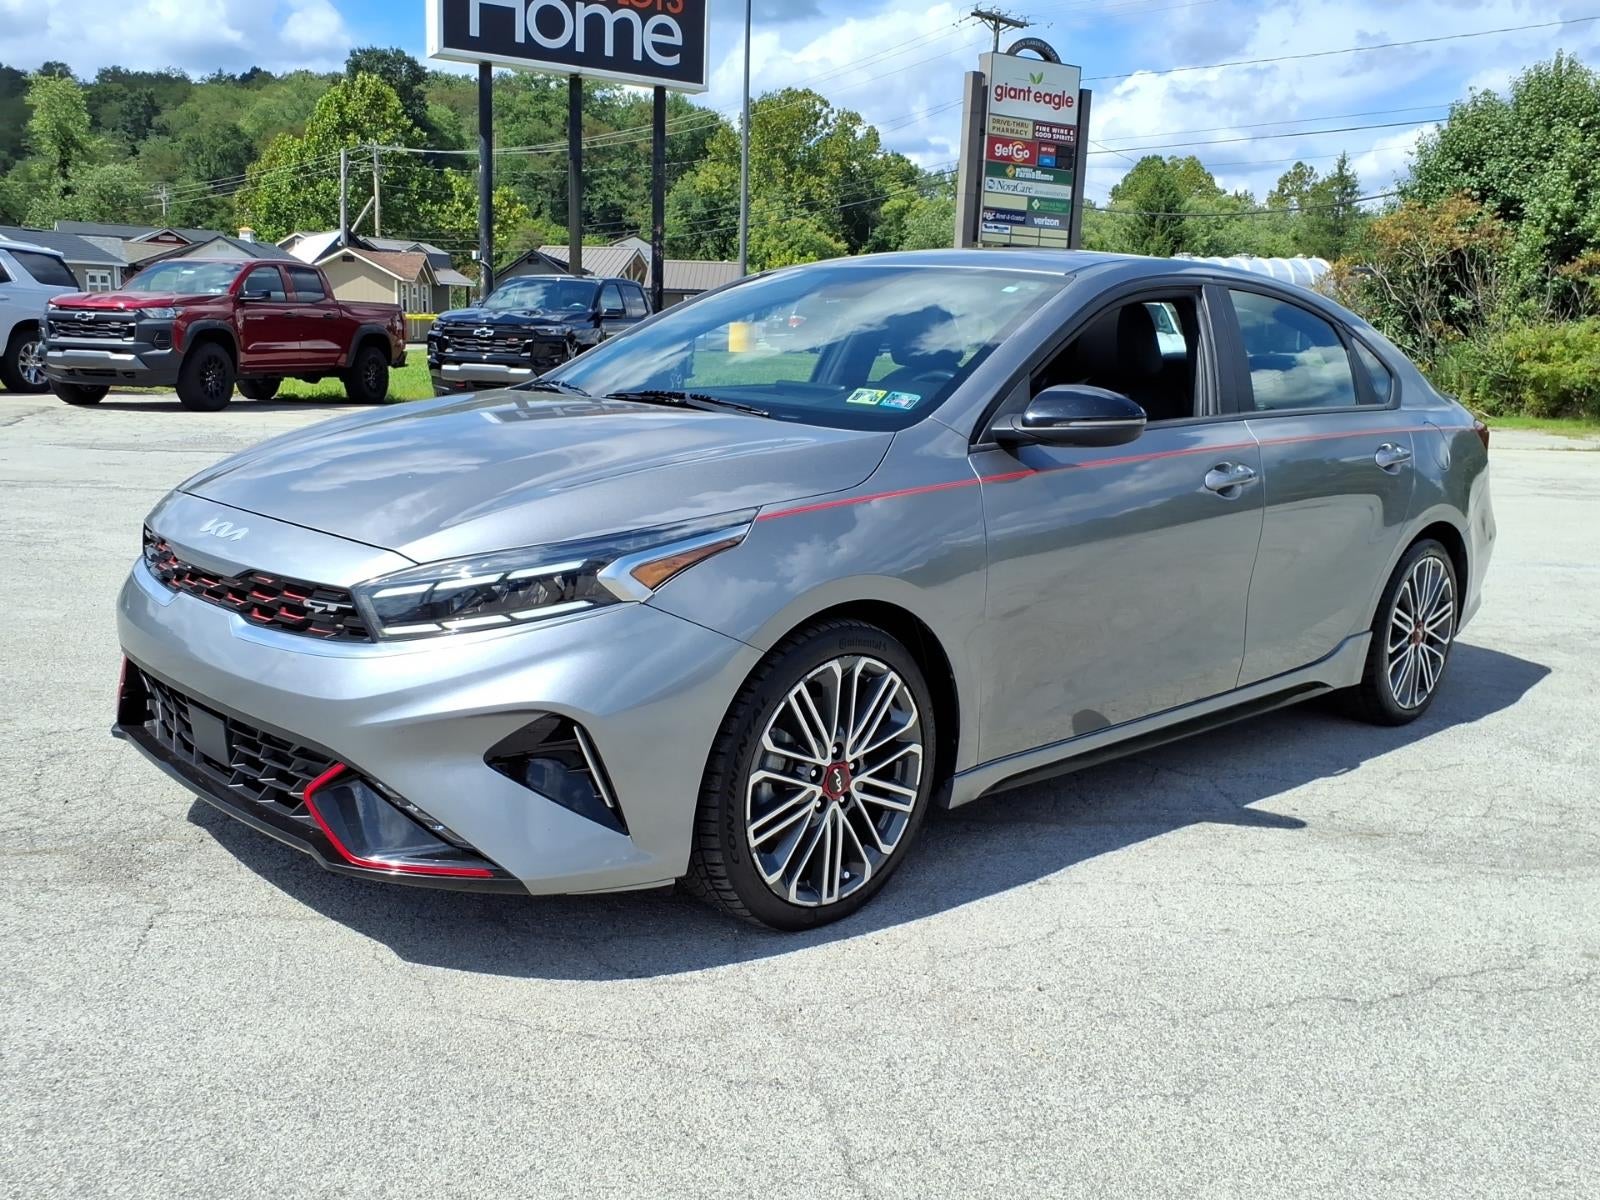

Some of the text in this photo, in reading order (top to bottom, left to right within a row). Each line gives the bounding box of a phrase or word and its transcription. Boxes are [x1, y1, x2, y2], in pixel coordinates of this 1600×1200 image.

[469, 0, 683, 66] Home
[994, 82, 1074, 110] giant eagle
[992, 127, 1028, 136] PHARMACY
[1035, 125, 1050, 133] FINE
[1052, 127, 1068, 135] WINE
[1035, 131, 1052, 139] GOOD
[994, 142, 1030, 159] getGo
[996, 180, 1033, 194] NovaCare
[1033, 216, 1060, 227] verizon
[199, 516, 250, 543] KIA
